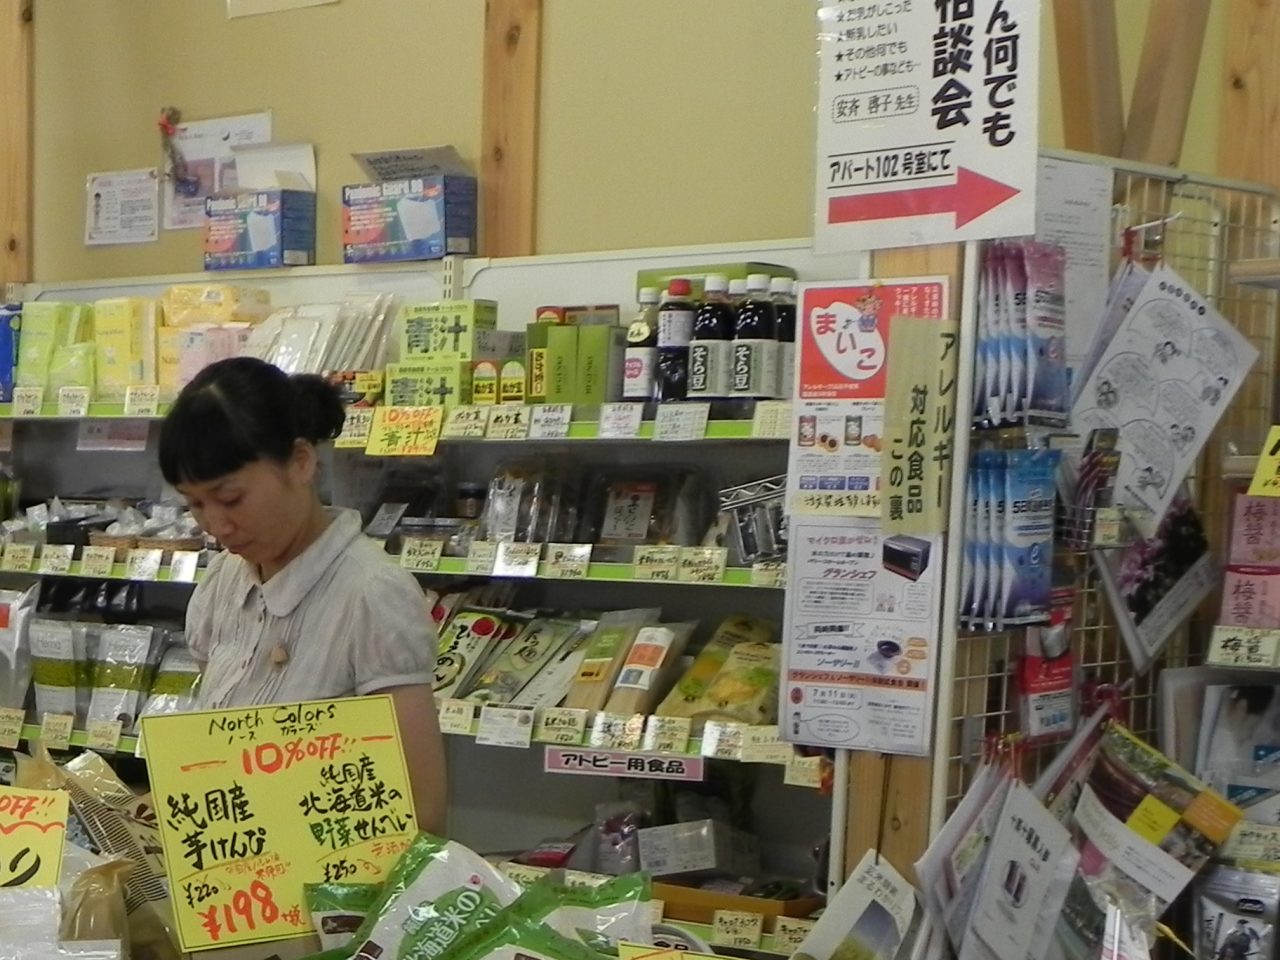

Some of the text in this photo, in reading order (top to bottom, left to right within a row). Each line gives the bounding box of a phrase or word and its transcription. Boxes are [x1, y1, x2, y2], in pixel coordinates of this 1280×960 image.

[692, 344, 708, 391] そら豆
[735, 344, 751, 391] そら豆
[932, 332, 956, 508] アレルギー
[907, 384, 927, 514] 対応食品
[889, 437, 904, 520] この裏
[209, 703, 337, 735] North Colors
[560, 753, 686, 775] アトピー用食品
[167, 780, 255, 833] 純国産
[180, 827, 268, 871] 芋けんぴ
[197, 879, 280, 941] ¥198
